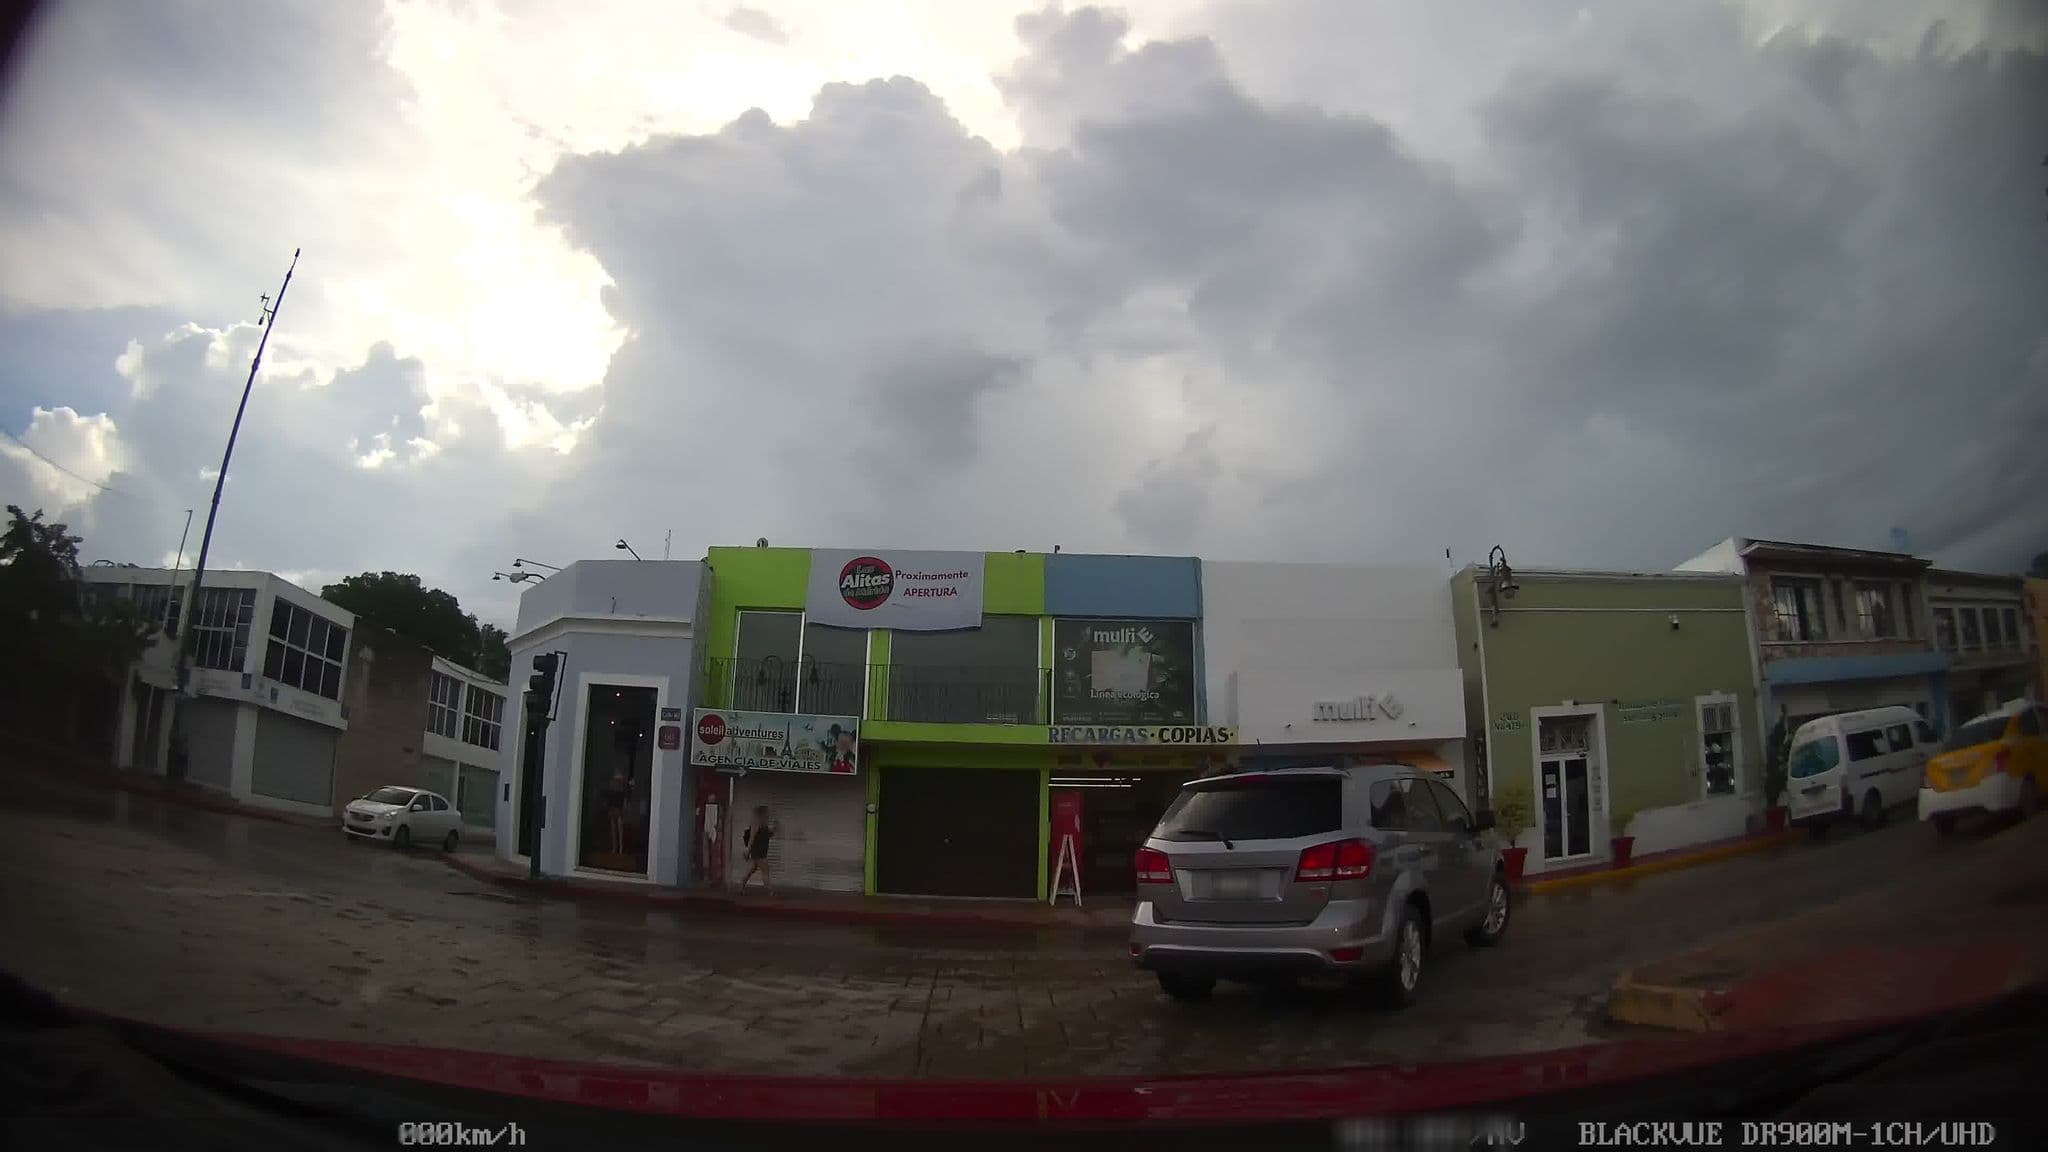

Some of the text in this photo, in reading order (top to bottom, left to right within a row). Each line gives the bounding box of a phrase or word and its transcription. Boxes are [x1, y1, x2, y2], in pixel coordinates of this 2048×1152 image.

[840, 573, 891, 589] Alitas
[895, 570, 969, 581] Proximamente
[903, 587, 958, 597] APERTURA
[1094, 627, 1136, 643] multi
[699, 724, 784, 740] soleil adventures
[1049, 727, 1230, 744] RECARGAS COPIAS
[698, 754, 821, 770] AGENCIA DE VIAJES
